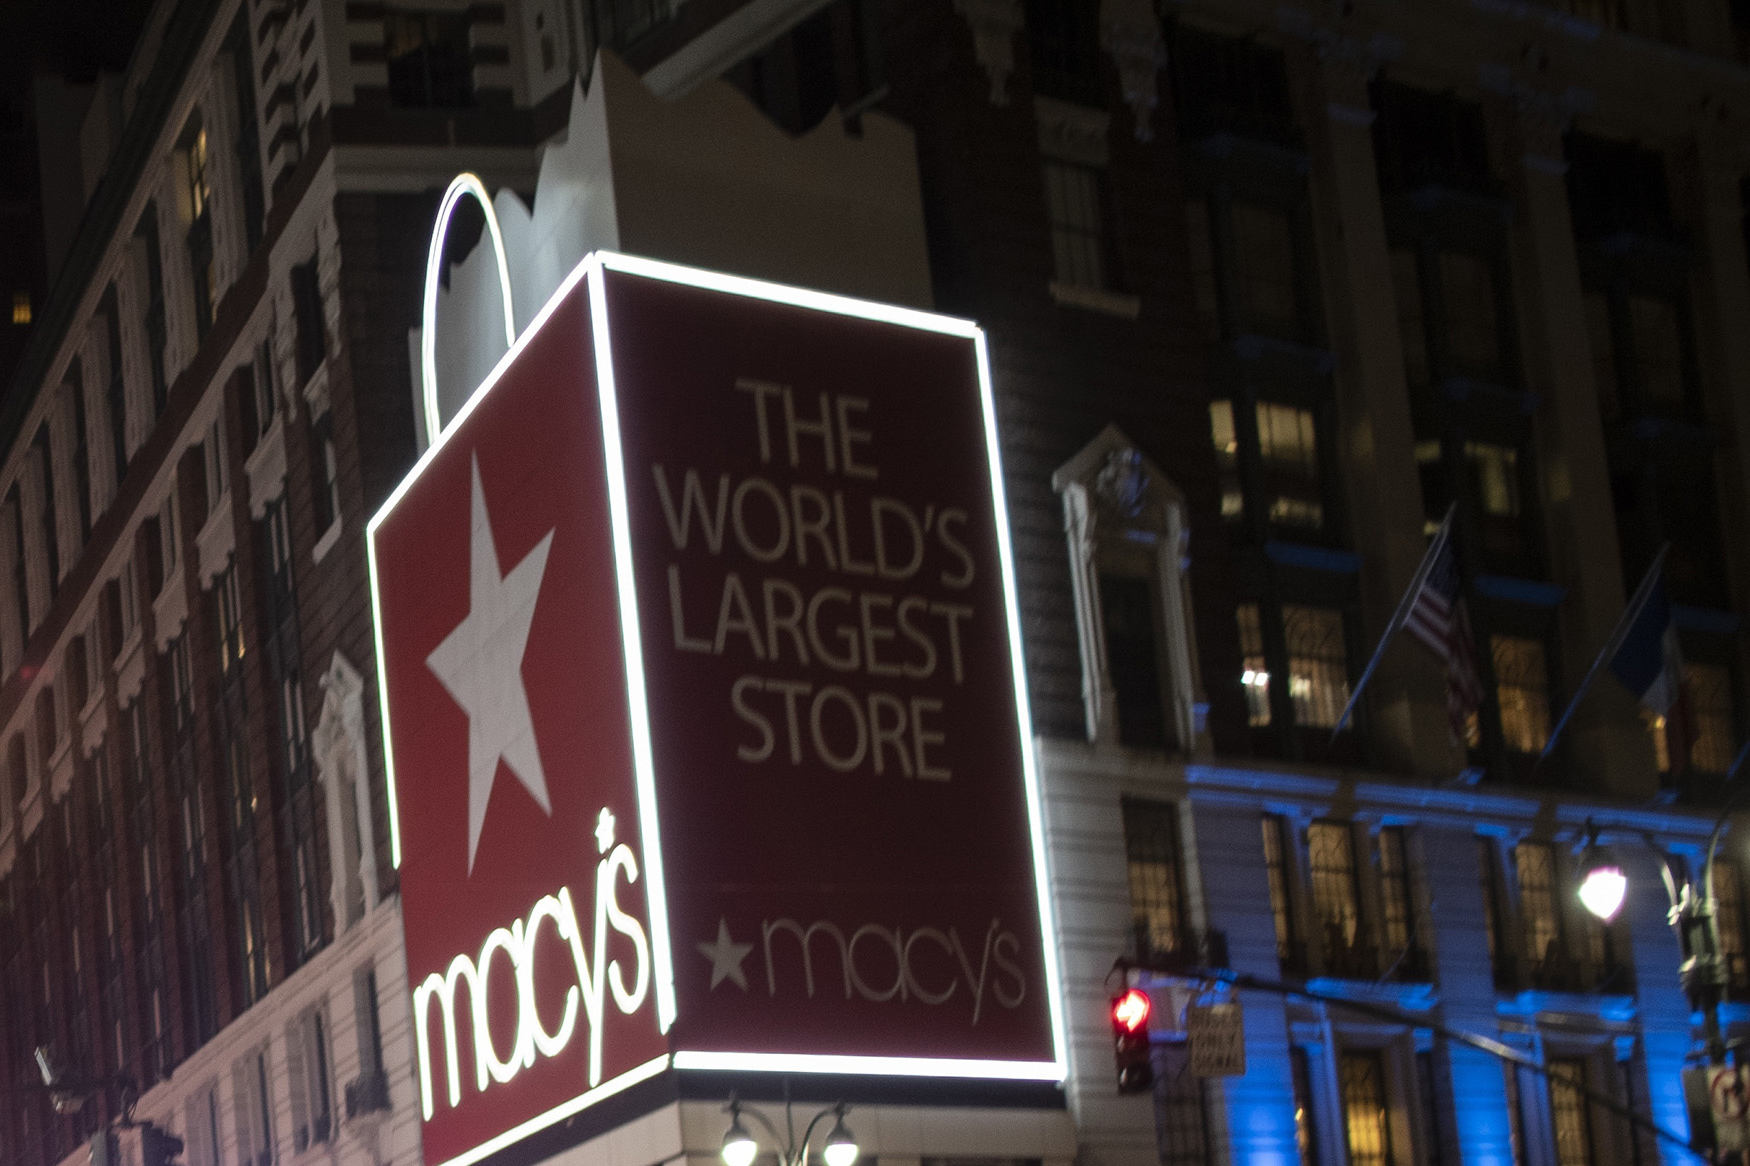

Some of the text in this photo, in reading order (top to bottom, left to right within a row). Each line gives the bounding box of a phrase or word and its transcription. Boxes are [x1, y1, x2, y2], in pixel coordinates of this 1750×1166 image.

[735, 378, 879, 480] THE
[653, 463, 975, 589] WORLD'S
[667, 563, 974, 685] LARGEST
[731, 675, 951, 783] STORE
[414, 843, 650, 1122] macy's
